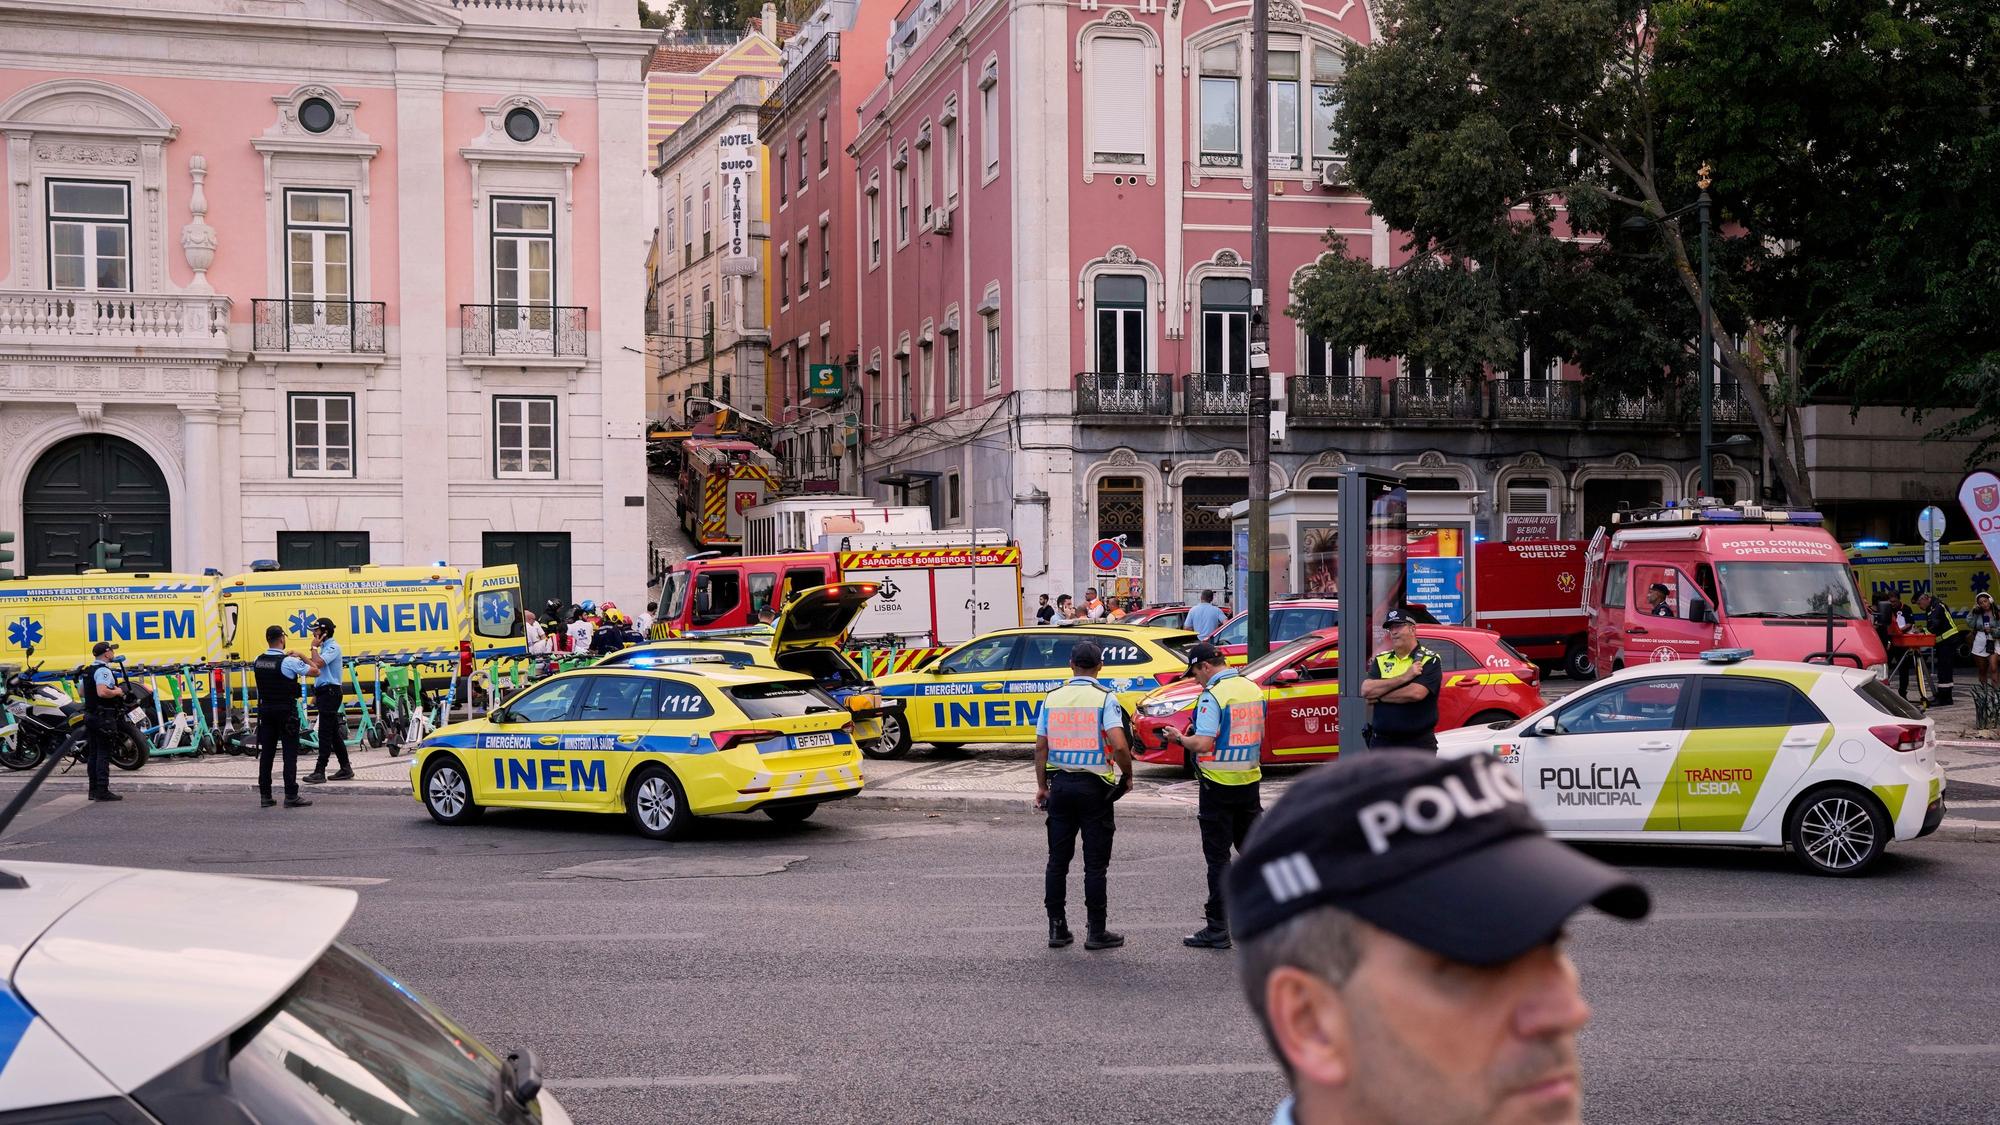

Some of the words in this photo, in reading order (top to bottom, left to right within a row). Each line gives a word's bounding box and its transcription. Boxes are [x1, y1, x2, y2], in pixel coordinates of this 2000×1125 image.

[720, 134, 753, 146] HOTEL
[1721, 540, 1765, 549] POSTO
[1769, 540, 1832, 550] COMANDO
[1735, 547, 1826, 556] OPERACIONAL
[916, 556, 965, 564] BOMBEIROS
[482, 576, 519, 587] AMBUL
[1871, 580, 1931, 594] INEM
[351, 602, 449, 634] INEM
[88, 610, 195, 642] INEM
[1108, 646, 1138, 660] 112
[432, 664, 454, 673] 112
[1493, 659, 1510, 667] 112
[924, 683, 974, 695] EMERGÊNCIA
[1009, 680, 1037, 693] MINISTÉRIO
[1037, 681, 1045, 692] DA
[671, 695, 702, 713] 112
[934, 700, 1043, 728] INEM
[1290, 706, 1338, 718] SAPADO
[485, 734, 531, 749] EMERGÊNCIA
[564, 735, 591, 749] MINISTÉRIO
[591, 737, 599, 750] DA
[599, 735, 615, 750] SAÚDE
[798, 737, 809, 747] BF
[810, 735, 819, 745] 57
[820, 734, 831, 745] PH
[1503, 756, 1519, 764] 229
[494, 758, 607, 792] INEM
[1540, 763, 1641, 790] POLÍCIA
[1684, 768, 1753, 782] TRÂNSITO
[1688, 782, 1741, 795] LISBOA
[1557, 792, 1642, 806] MUNICIPAL
